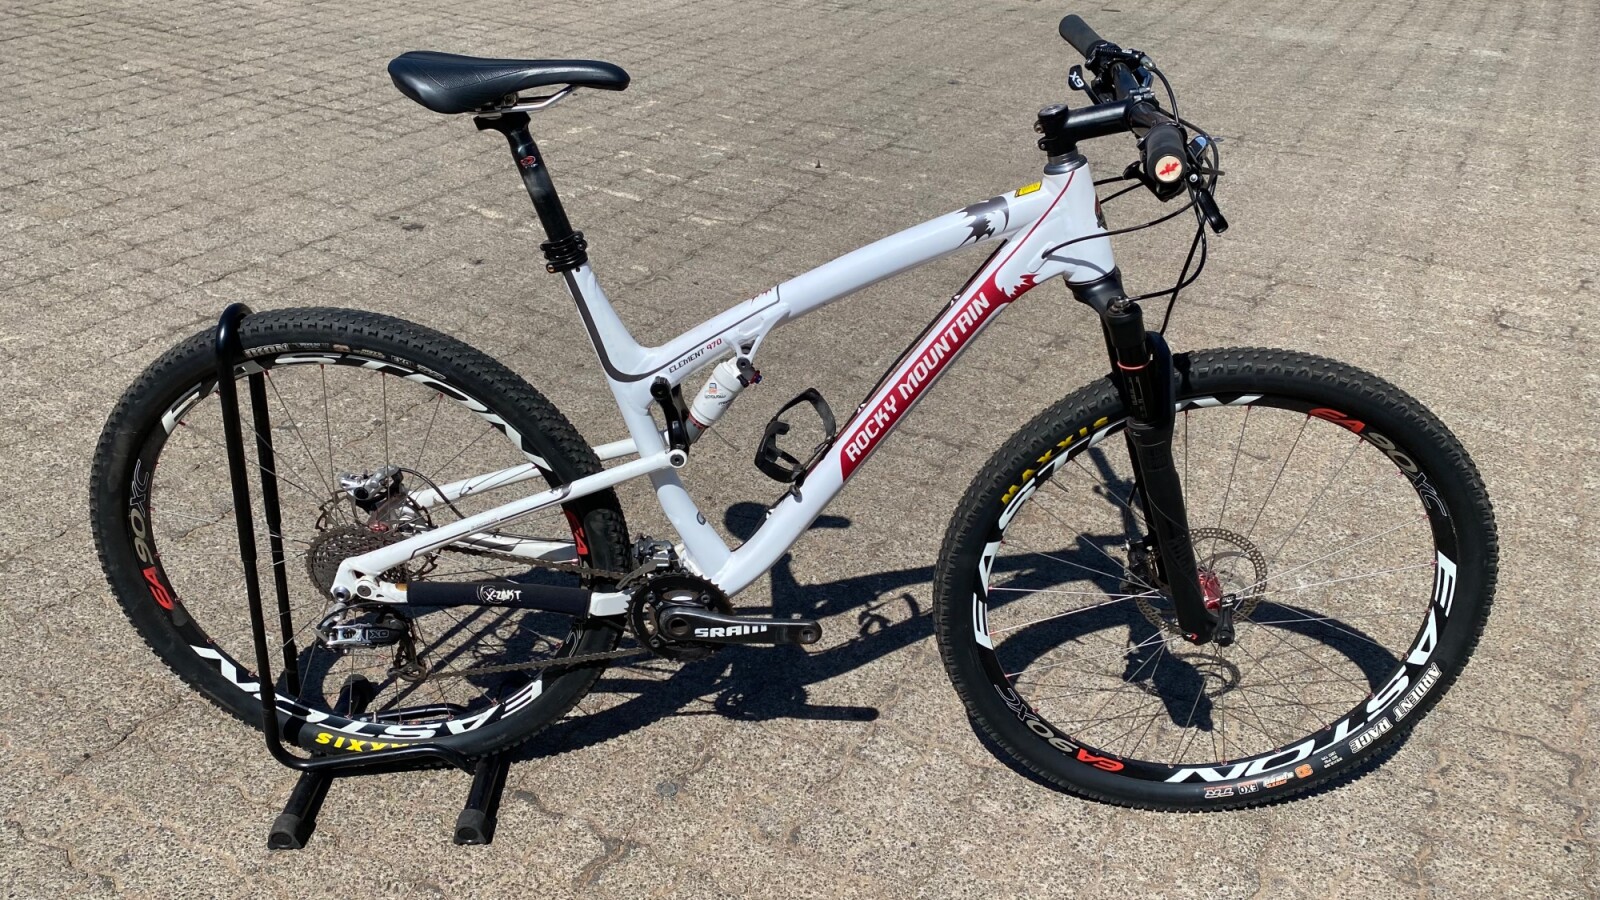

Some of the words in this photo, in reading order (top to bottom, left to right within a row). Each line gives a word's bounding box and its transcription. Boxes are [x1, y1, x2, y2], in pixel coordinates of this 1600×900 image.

[1068, 70, 1085, 88] X9
[668, 347, 706, 374] ELEMENT
[706, 338, 723, 351] 970
[844, 394, 898, 463] ROCKY
[897, 291, 991, 400] MOUNTAIN
[1001, 416, 1109, 505] MAXXIS
[694, 624, 768, 638] SRAM
[1164, 550, 1457, 783] EASTON
[1393, 662, 1442, 722] ARDENT
[1349, 717, 1393, 753] RACE
[1238, 783, 1259, 795] EXO
